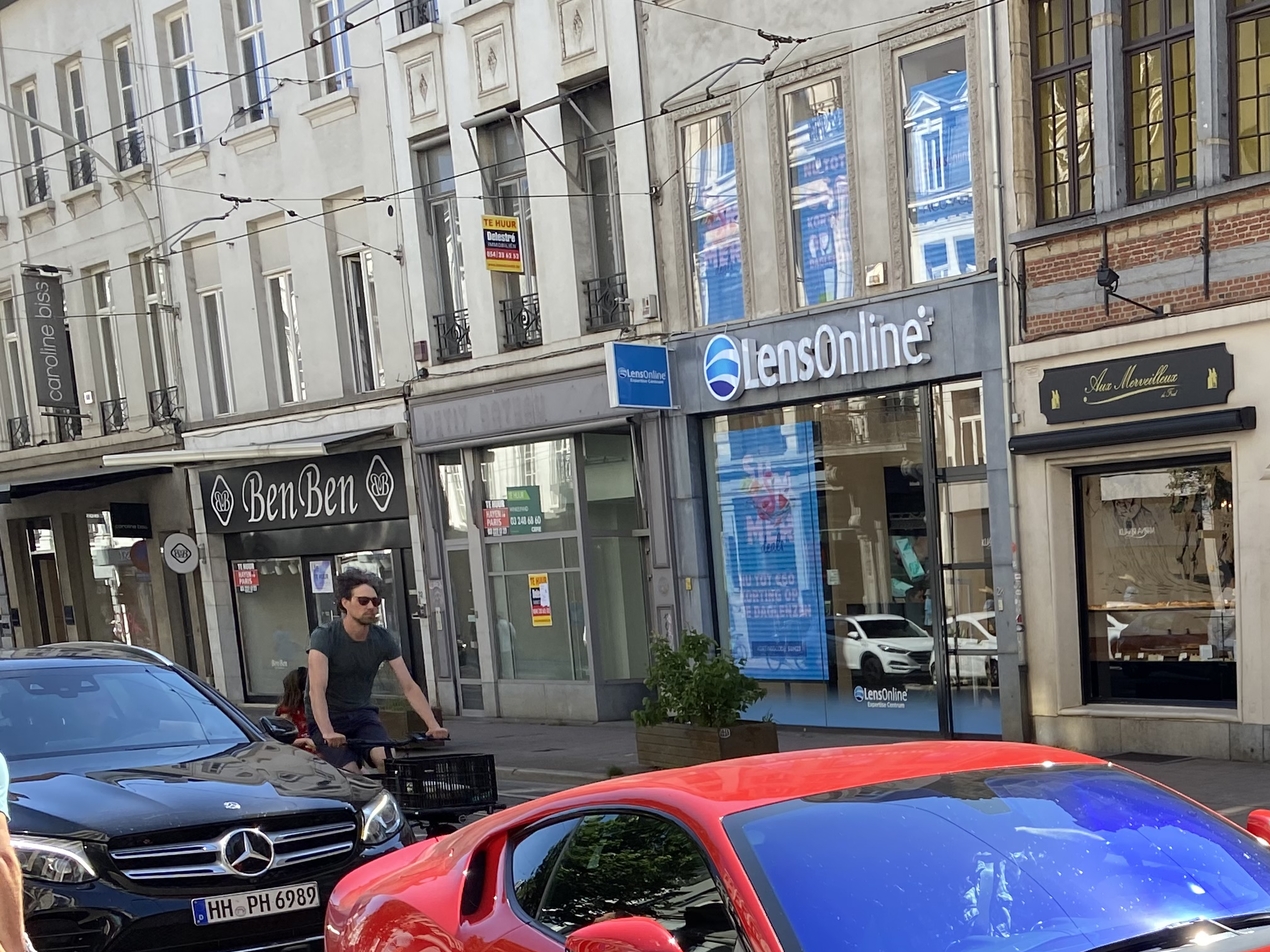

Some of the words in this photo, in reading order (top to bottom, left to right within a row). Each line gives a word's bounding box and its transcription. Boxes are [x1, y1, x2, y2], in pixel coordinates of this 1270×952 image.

[484, 219, 493, 227] TE
[496, 220, 517, 229] HUUR
[34, 282, 52, 318] biss
[40, 324, 63, 402] caroline
[741, 305, 931, 390] LensOnline
[627, 368, 667, 380] LensOnline
[1084, 368, 1112, 394] Aux
[1113, 364, 1178, 391] Merveilleux
[864, 687, 908, 702] LensOnline
[208, 899, 234, 920] HH
[246, 894, 271, 914] PH
[276, 886, 316, 909] 6989
